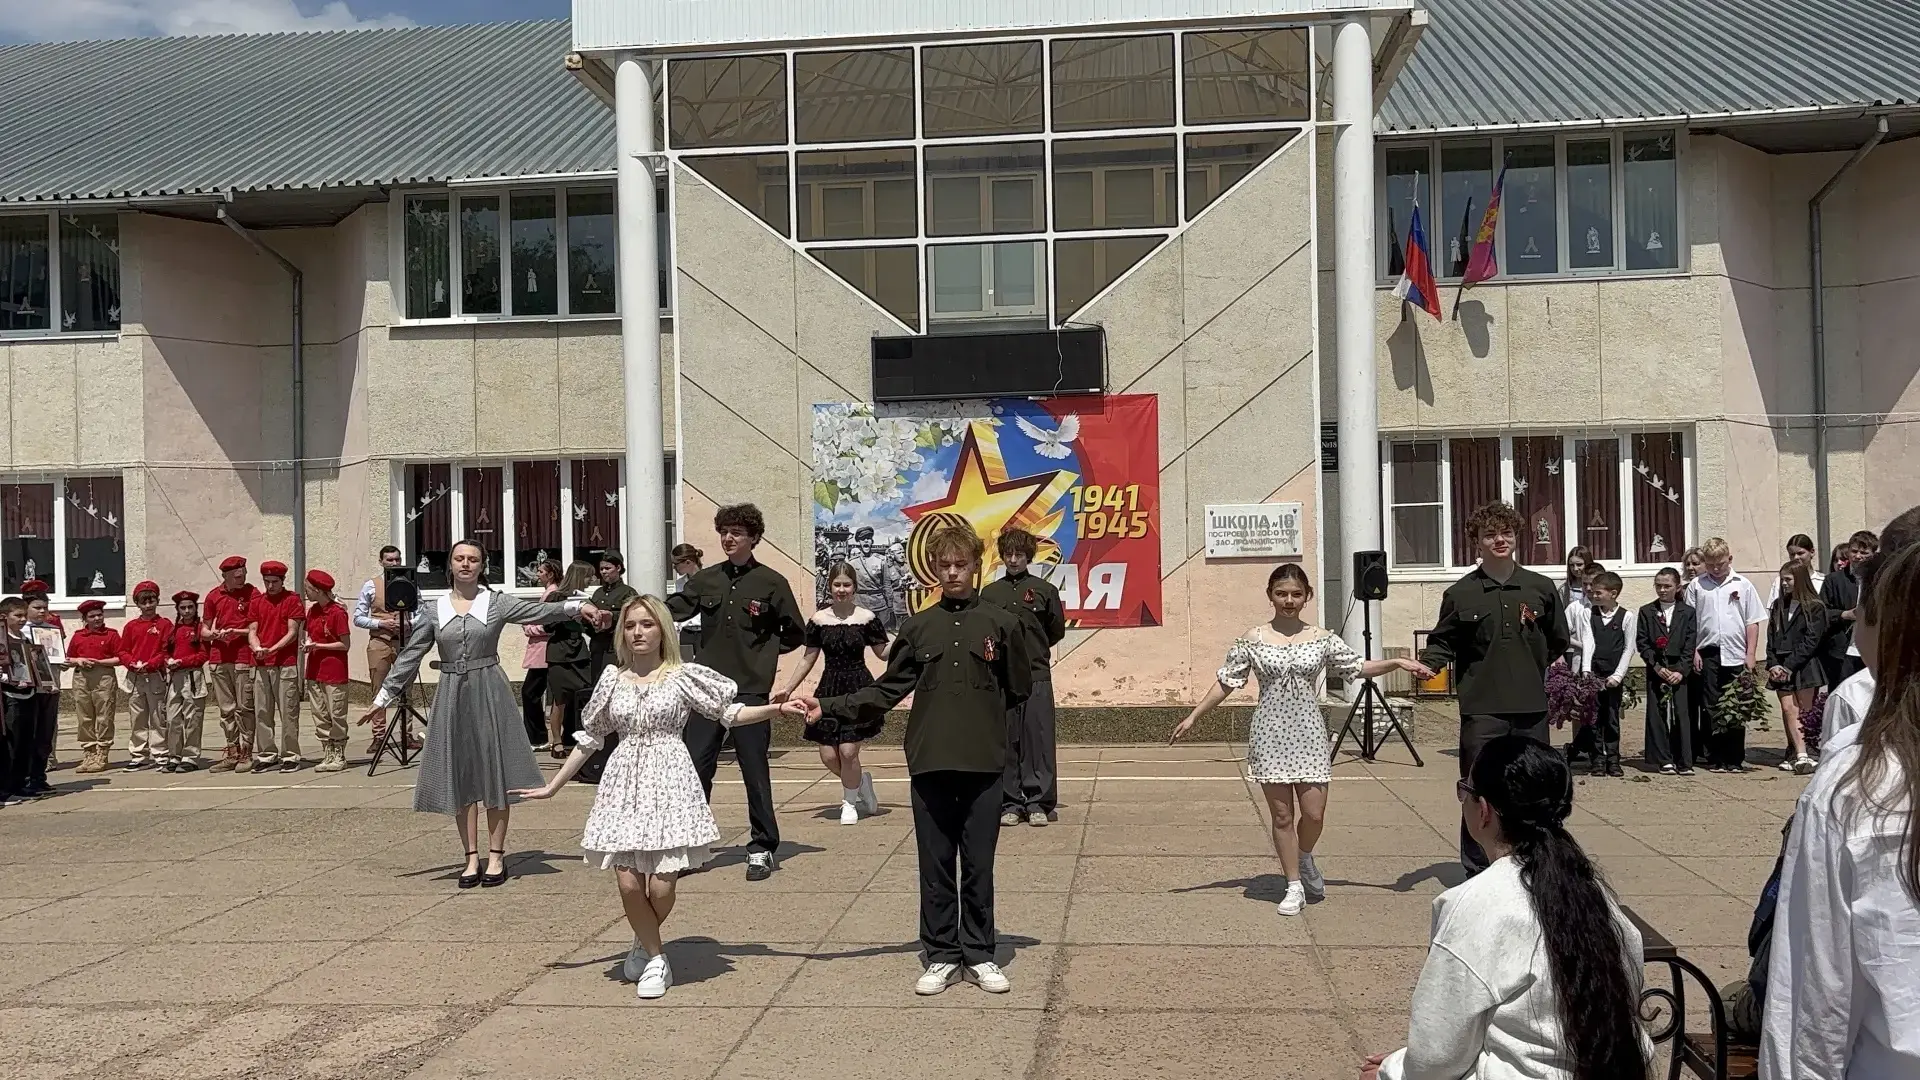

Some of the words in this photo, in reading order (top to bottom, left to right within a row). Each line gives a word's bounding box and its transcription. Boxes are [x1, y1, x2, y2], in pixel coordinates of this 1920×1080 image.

[1069, 484, 1139, 512] 1941
[1073, 511, 1149, 539] 1945
[1212, 515, 1270, 530] ШКОЛА
